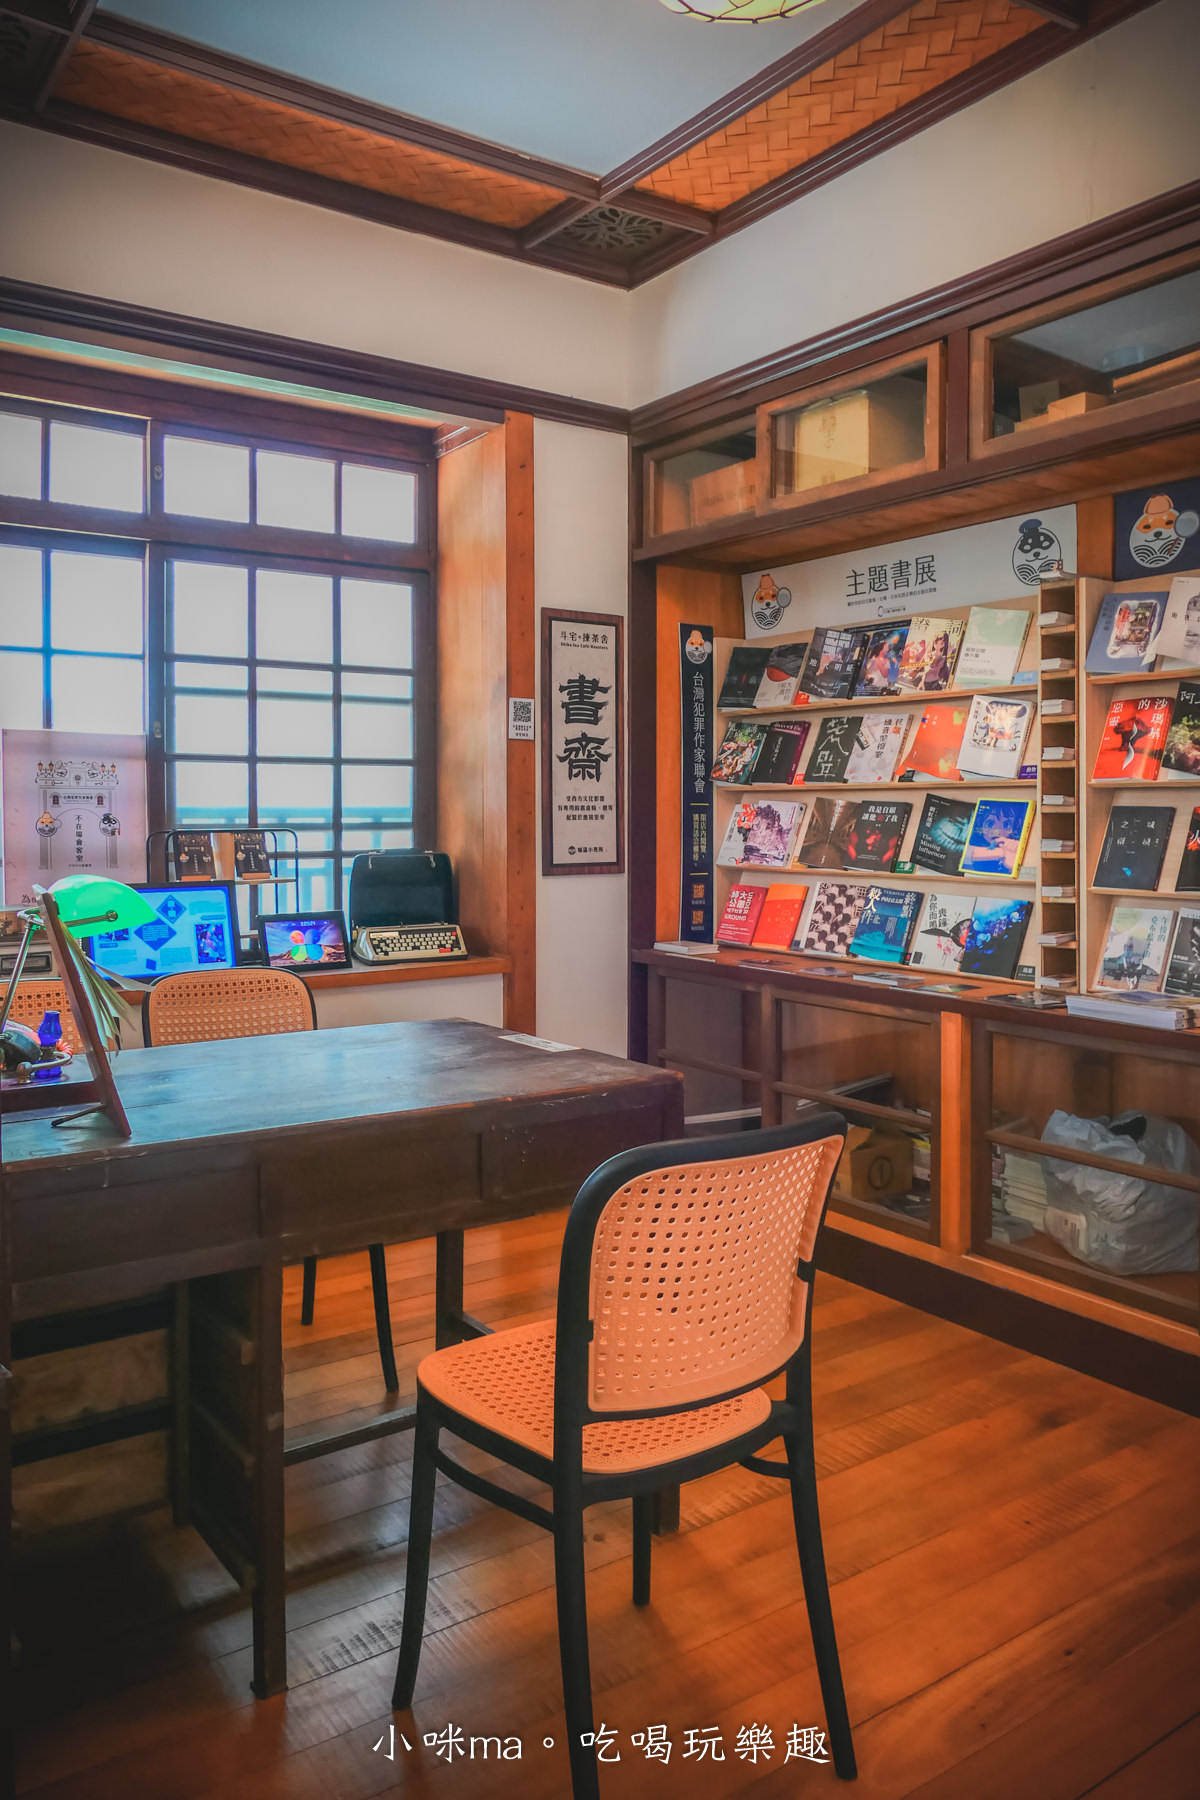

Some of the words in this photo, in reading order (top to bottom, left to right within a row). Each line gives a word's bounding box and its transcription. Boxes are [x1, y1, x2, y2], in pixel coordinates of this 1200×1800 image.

[846, 555, 936, 597] 主題書展
[1137, 698, 1151, 710] 的
[556, 672, 612, 782] 書齋
[693, 671, 706, 793] 台灣犯罪作家聯會
[920, 840, 942, 852] Missing
[922, 833, 932, 841] The
[919, 846, 946, 859] Influencer
[929, 894, 938, 928] 為你而鳴
